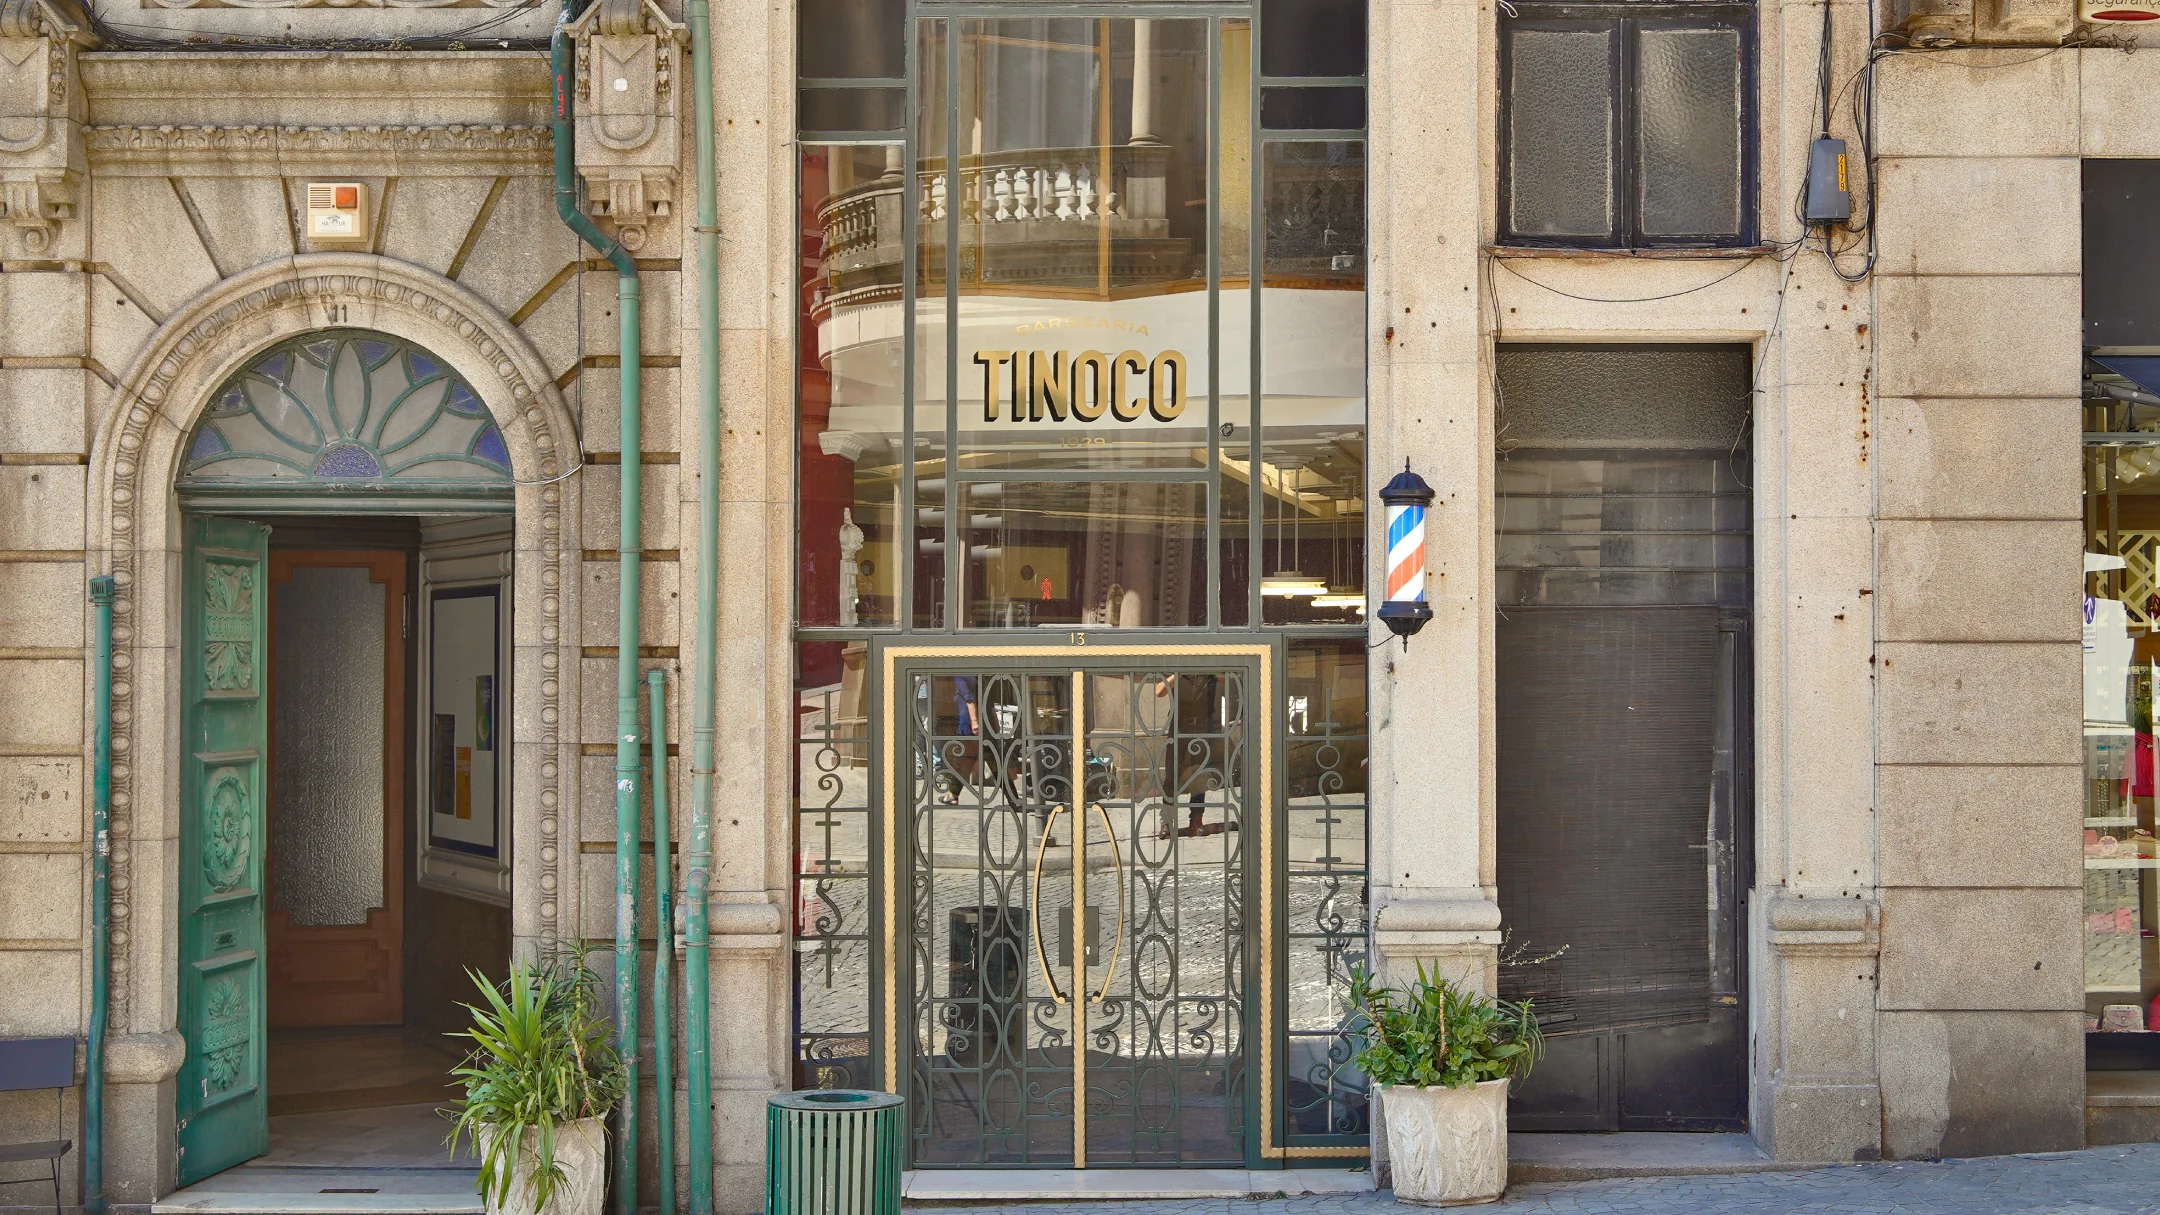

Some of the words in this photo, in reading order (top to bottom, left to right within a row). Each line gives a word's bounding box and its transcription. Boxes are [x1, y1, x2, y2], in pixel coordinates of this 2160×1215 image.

[1016, 315, 1149, 337] BARBEARIA
[973, 349, 1187, 423] TINOCO
[1059, 436, 1106, 448] 1929
[1070, 632, 1085, 646] 13
